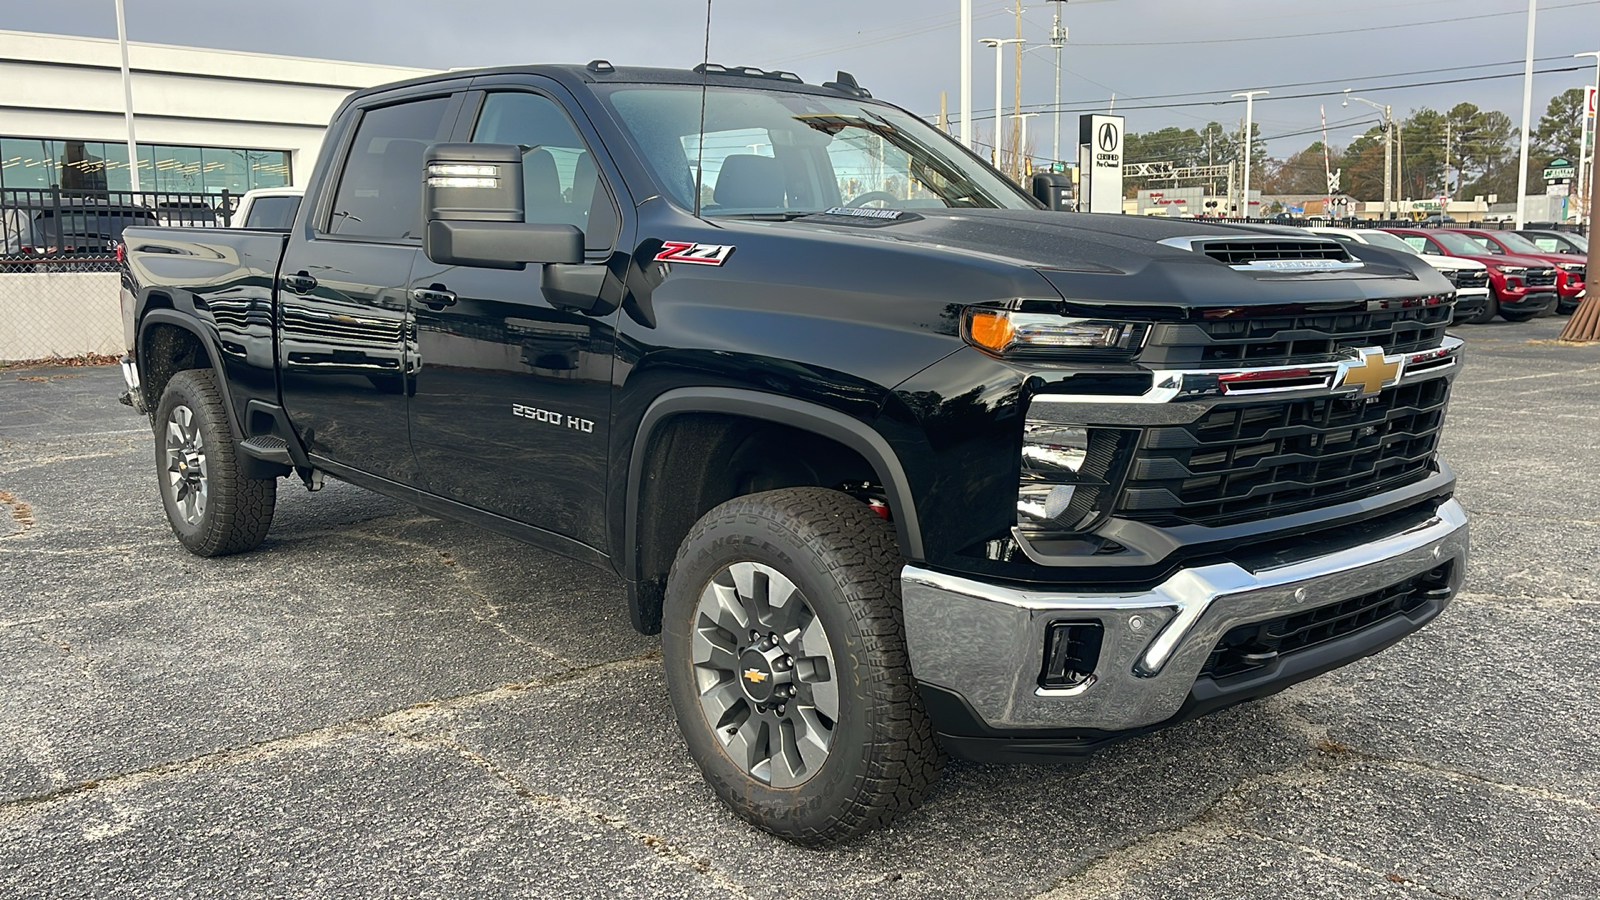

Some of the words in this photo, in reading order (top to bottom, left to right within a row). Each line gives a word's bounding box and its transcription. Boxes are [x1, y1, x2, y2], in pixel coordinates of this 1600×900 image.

[854, 208, 902, 219] DURAMAX
[653, 241, 737, 266] Z71
[512, 403, 563, 425] 2500
[567, 415, 595, 433] HD
